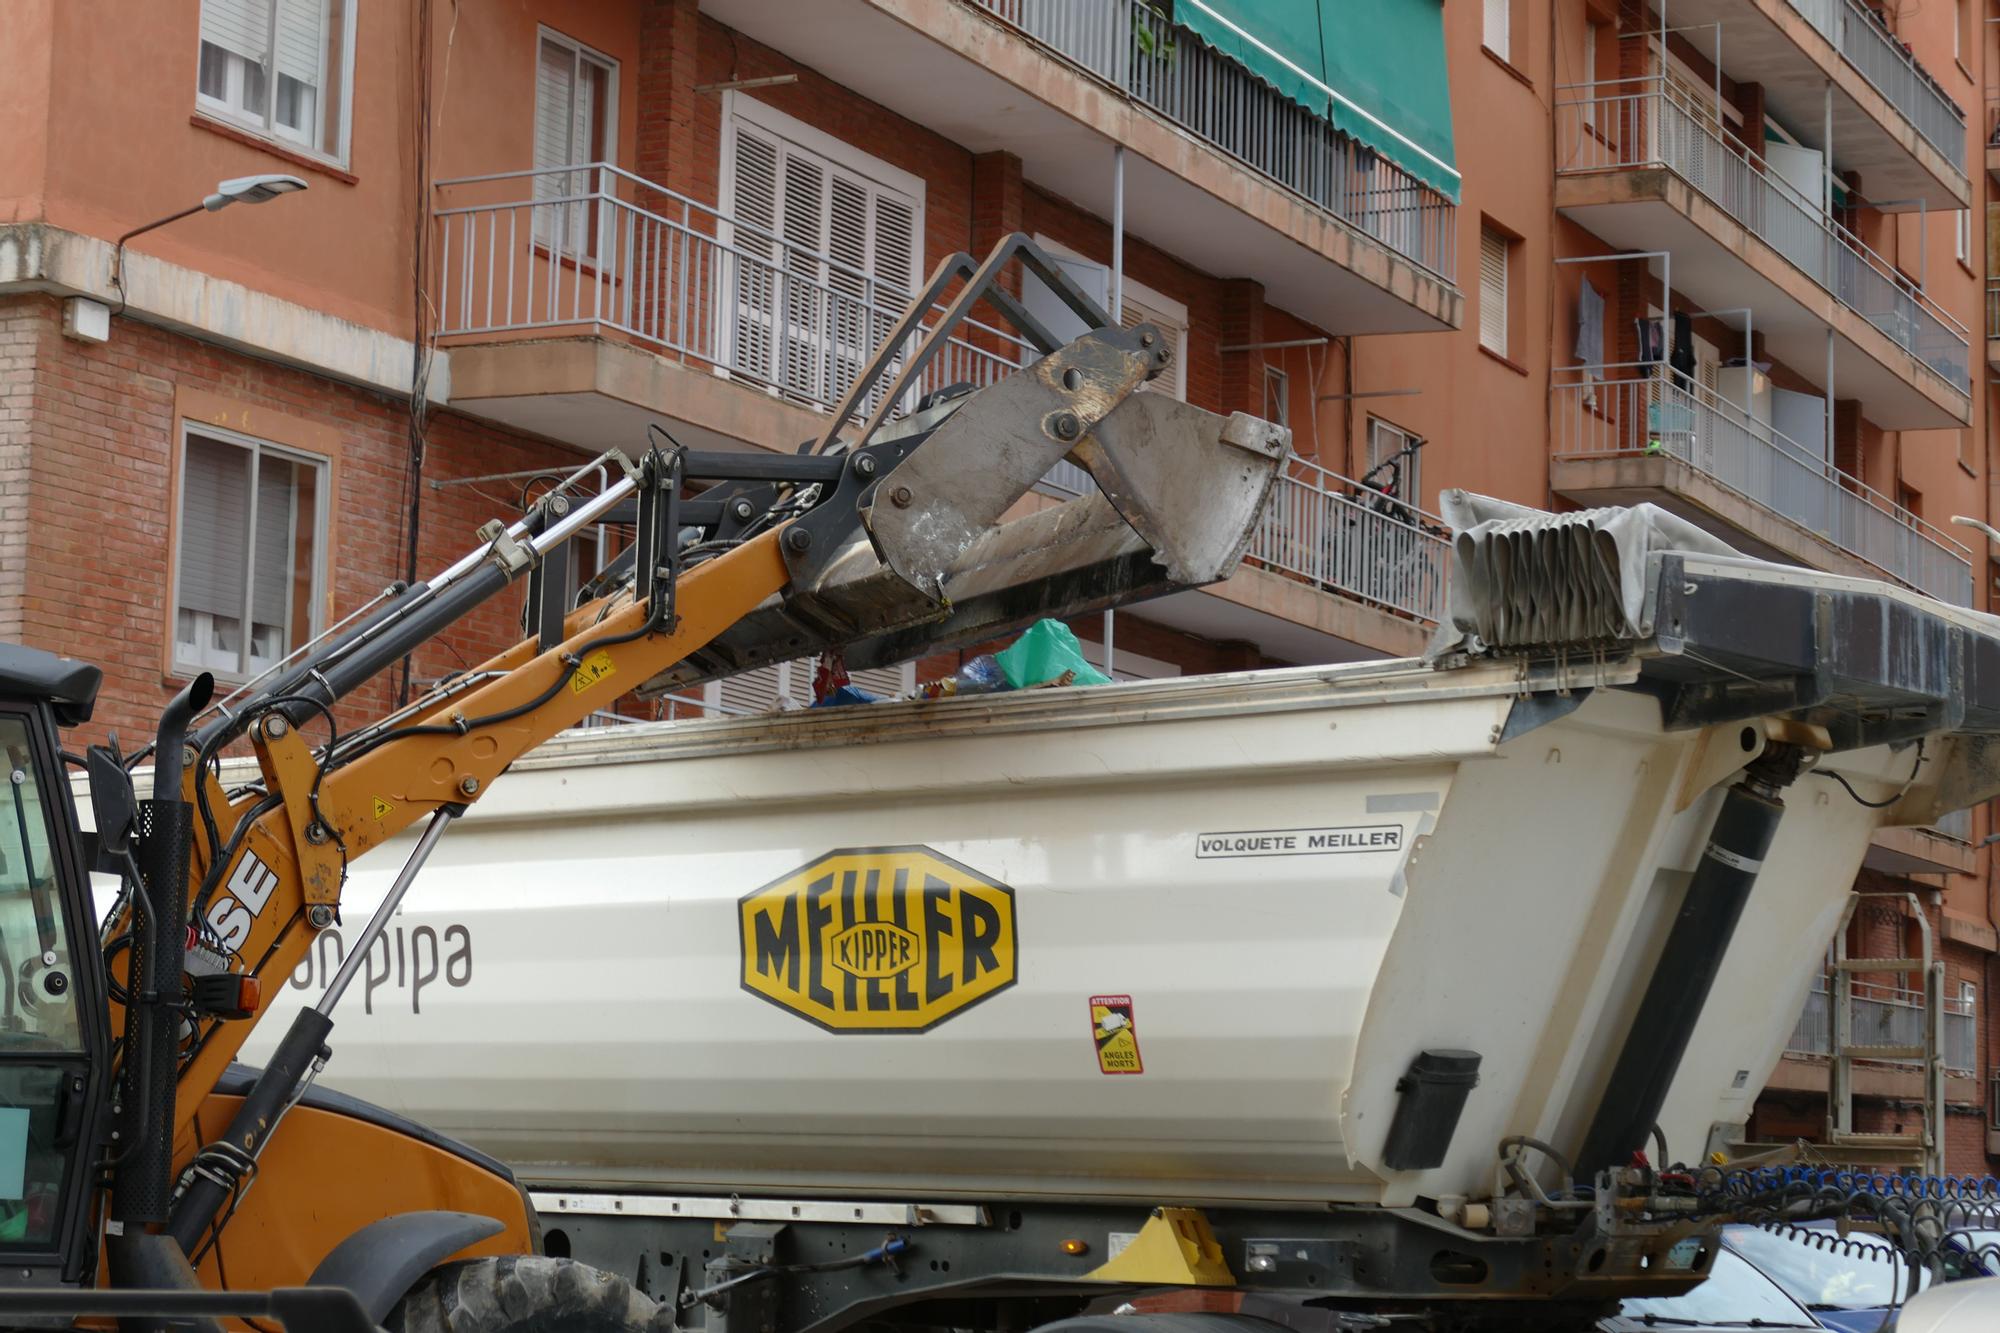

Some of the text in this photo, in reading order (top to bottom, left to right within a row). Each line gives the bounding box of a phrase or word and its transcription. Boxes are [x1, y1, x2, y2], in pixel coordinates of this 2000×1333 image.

[1201, 832, 1399, 852] VOLQUETE MEILLER
[207, 847, 280, 960] SE
[364, 904, 472, 1015] pipa
[754, 868, 1001, 1012] MEILLER
[840, 929, 911, 971] KIPPER
[1104, 1051, 1135, 1059] ANGLES
[1107, 1060, 1136, 1068] MORTS
